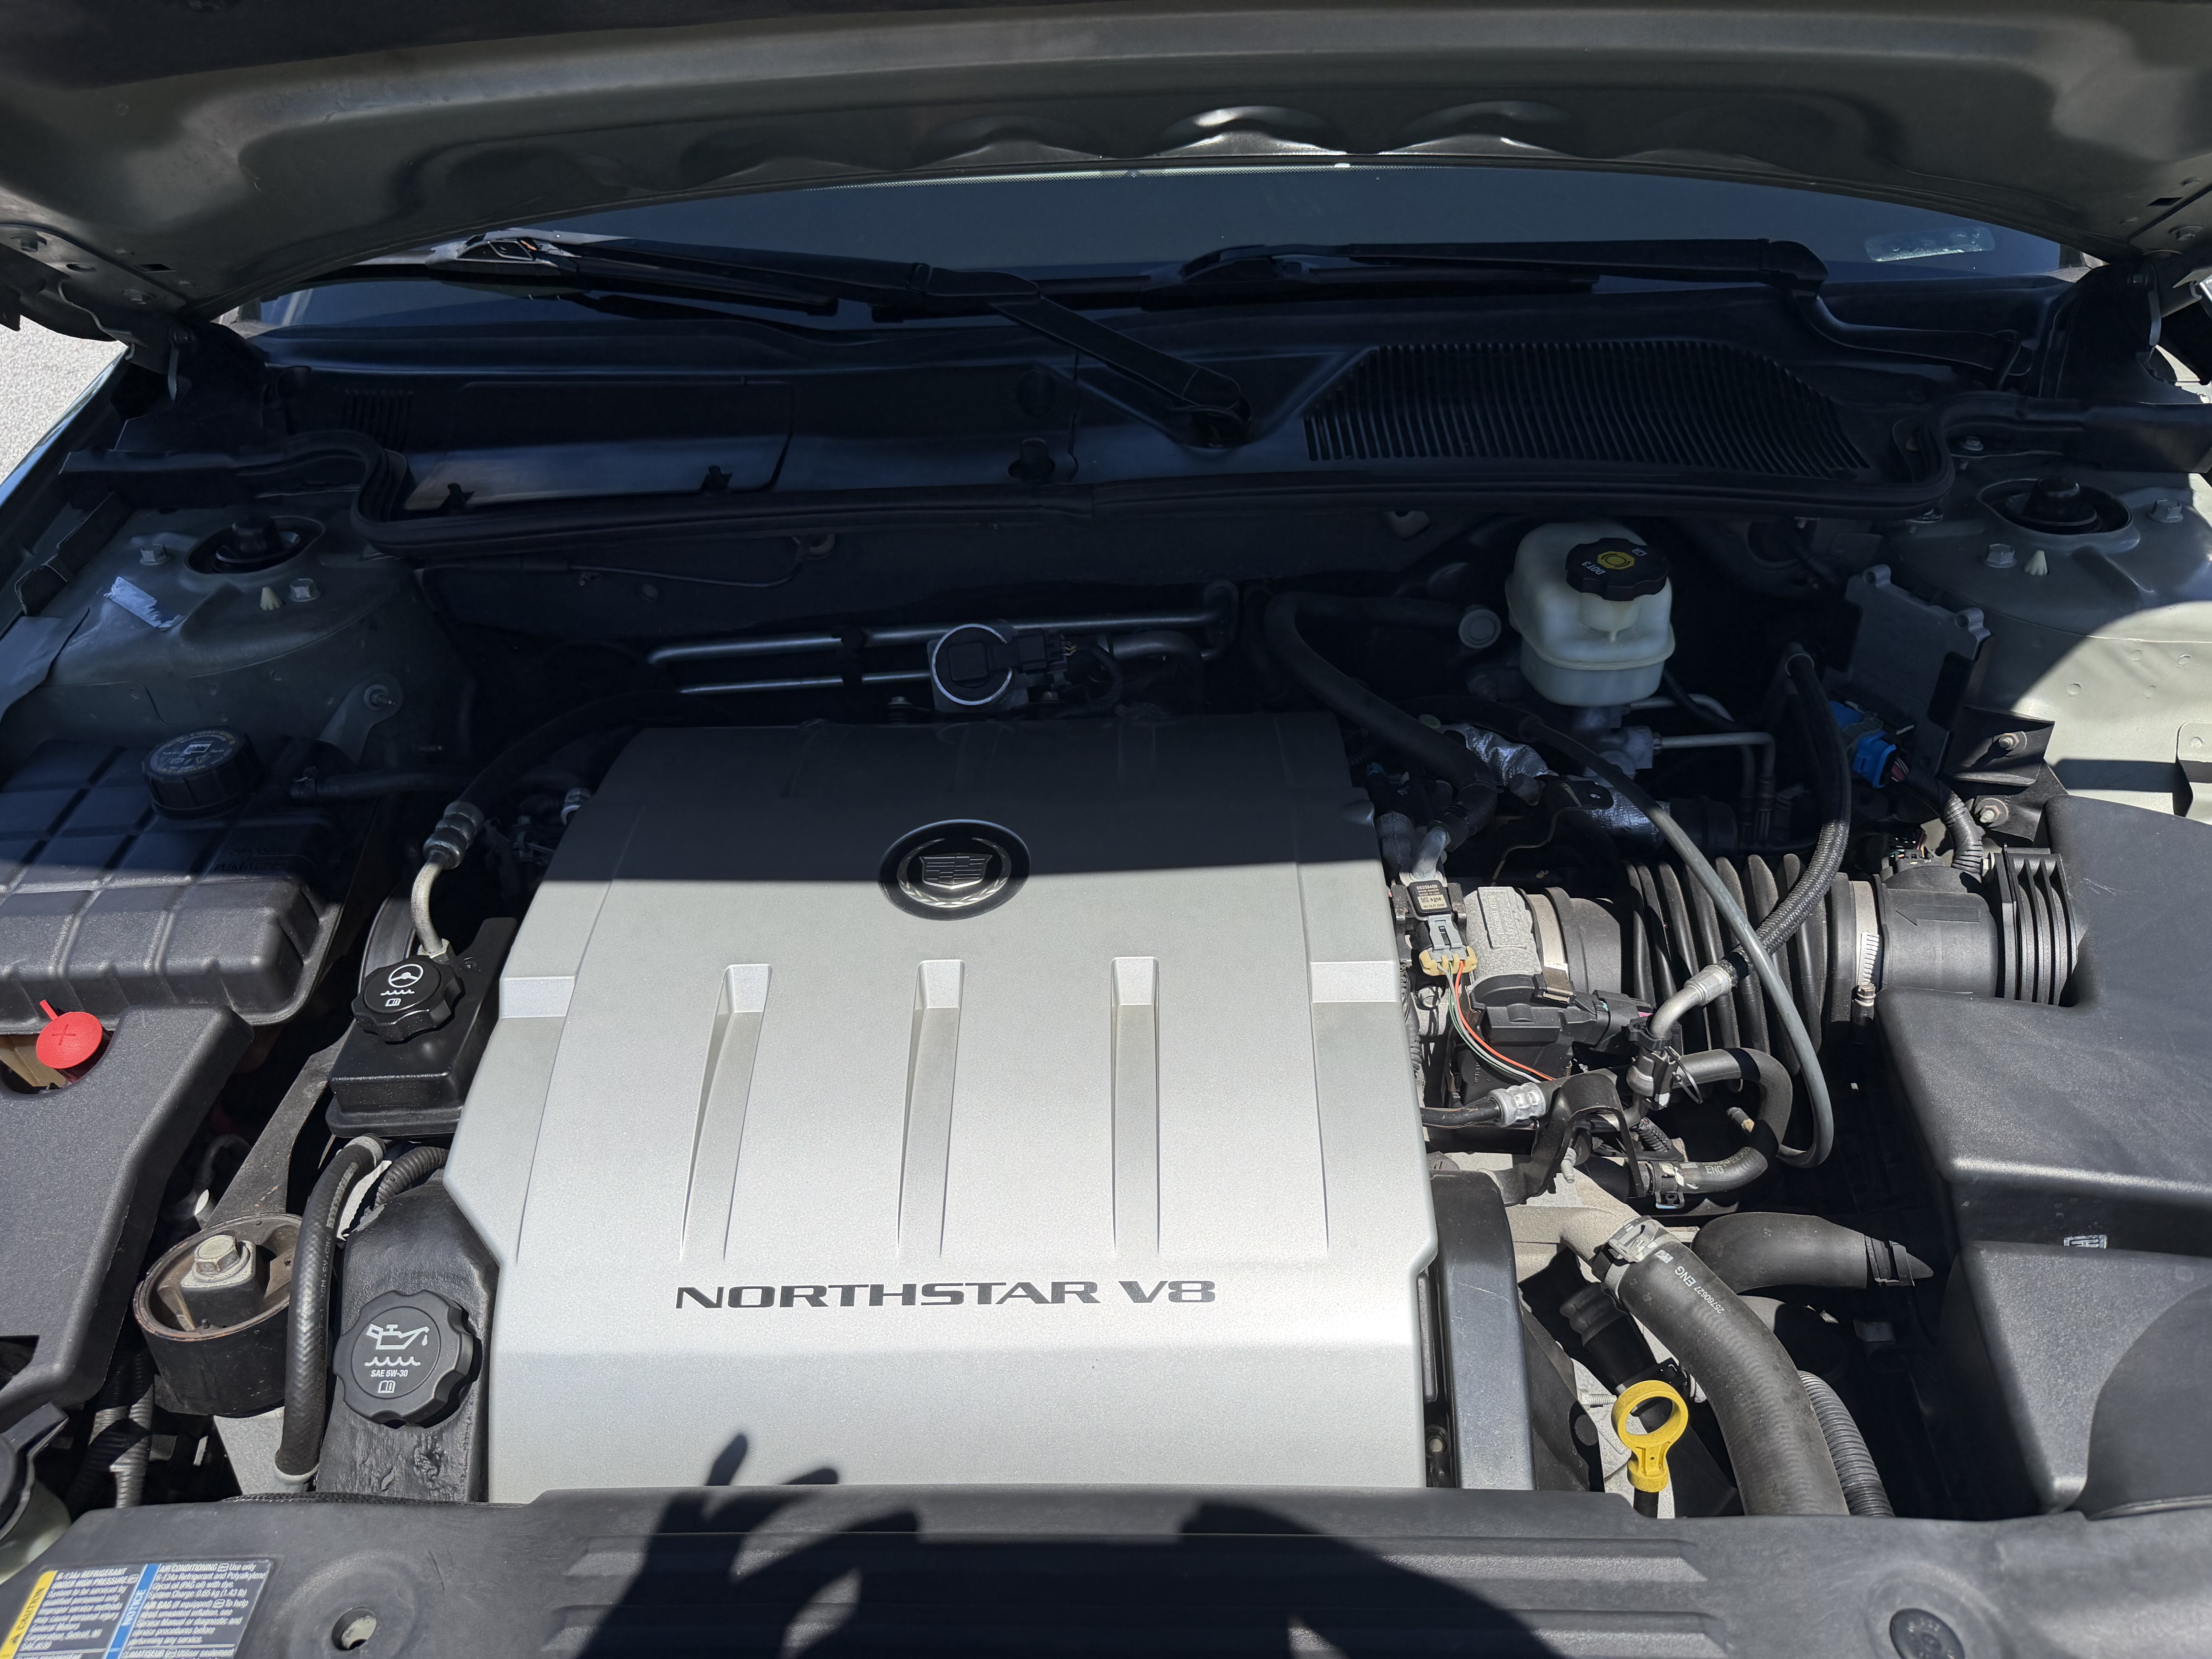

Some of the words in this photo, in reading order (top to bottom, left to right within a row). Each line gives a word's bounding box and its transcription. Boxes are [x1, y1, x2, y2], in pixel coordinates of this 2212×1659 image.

[1704, 1165, 1724, 1175] ENG
[1674, 1266, 1696, 1287] ENG
[676, 1281, 1101, 1309] NORTHSTAR
[1118, 1281, 1216, 1304] V8
[1693, 1286, 1724, 1313] 25760627
[172, 1563, 218, 1572] CONDITIONING
[229, 1563, 242, 1571] Use
[241, 1563, 256, 1572] only
[81, 1568, 127, 1579] REFRIGERANT
[156, 1573, 178, 1582] R-134a
[178, 1572, 214, 1581] Refrigerant
[213, 1571, 227, 1580] and
[227, 1571, 266, 1581] Polyalkylene
[52, 1580, 76, 1590] UNDER
[75, 1578, 93, 1588] HIGH
[91, 1575, 129, 1587] PRESSURE
[152, 1582, 171, 1591] Glycol
[171, 1581, 180, 1589] oil
[180, 1581, 196, 1590] (PAG
[195, 1580, 207, 1590] oil)
[206, 1580, 221, 1588] with
[221, 1580, 234, 1589] dye.
[89, 1585, 119, 1595] serviced
[117, 1585, 128, 1594] by
[148, 1590, 172, 1600] System
[195, 1589, 212, 1598] 0.65
[210, 1589, 220, 1599] kg
[220, 1589, 238, 1597] (1.43
[237, 1588, 247, 1598] lb)
[16, 1587, 45, 1631] CAUTION
[93, 1602, 124, 1611] methods
[122, 1589, 146, 1626] NOTICE
[143, 1600, 157, 1610] AIR
[156, 1600, 173, 1610] BAG
[179, 1599, 213, 1609] equipped)
[225, 1599, 233, 1608] To
[232, 1599, 249, 1609] help
[69, 1611, 100, 1622] personal
[158, 1609, 192, 1618] unwanted
[190, 1608, 219, 1617] inflation,
[218, 1609, 233, 1617] see
[160, 1617, 187, 1627] Manual
[193, 1617, 228, 1627] diagnostic
[227, 1616, 243, 1625] and
[154, 1626, 193, 1637] procedures
[192, 1626, 216, 1635] before
[162, 1637, 178, 1647] any
[177, 1635, 203, 1644] service.
[177, 1649, 201, 1658] Utiliser
[200, 1648, 235, 1657] seulement
